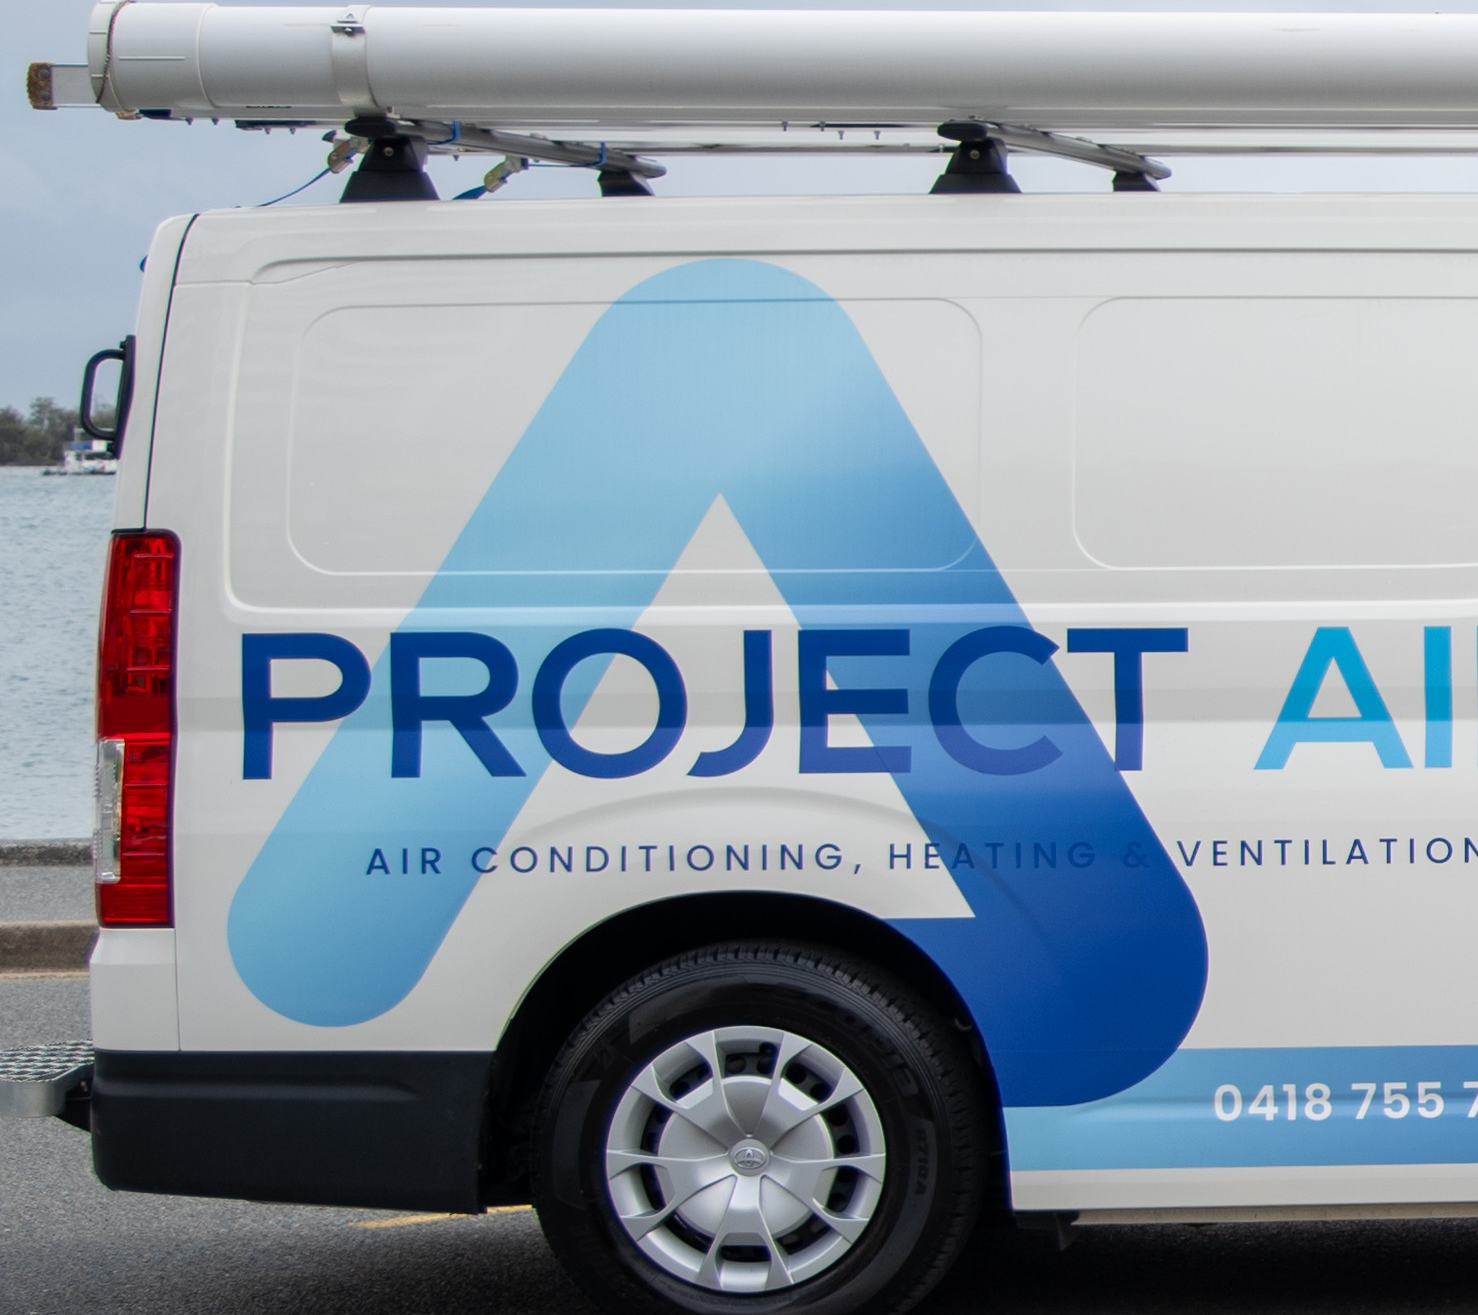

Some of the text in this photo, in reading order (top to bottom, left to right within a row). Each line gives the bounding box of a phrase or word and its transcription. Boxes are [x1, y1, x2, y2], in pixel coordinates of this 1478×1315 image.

[242, 625, 1188, 780] PROJECT
[366, 846, 442, 875] AIR
[470, 840, 863, 875] CONDITIONING,
[889, 840, 1097, 870] HEATING
[1122, 839, 1149, 869] &
[1214, 1083, 1332, 1122] 0418
[1351, 1082, 1445, 1120] 755
